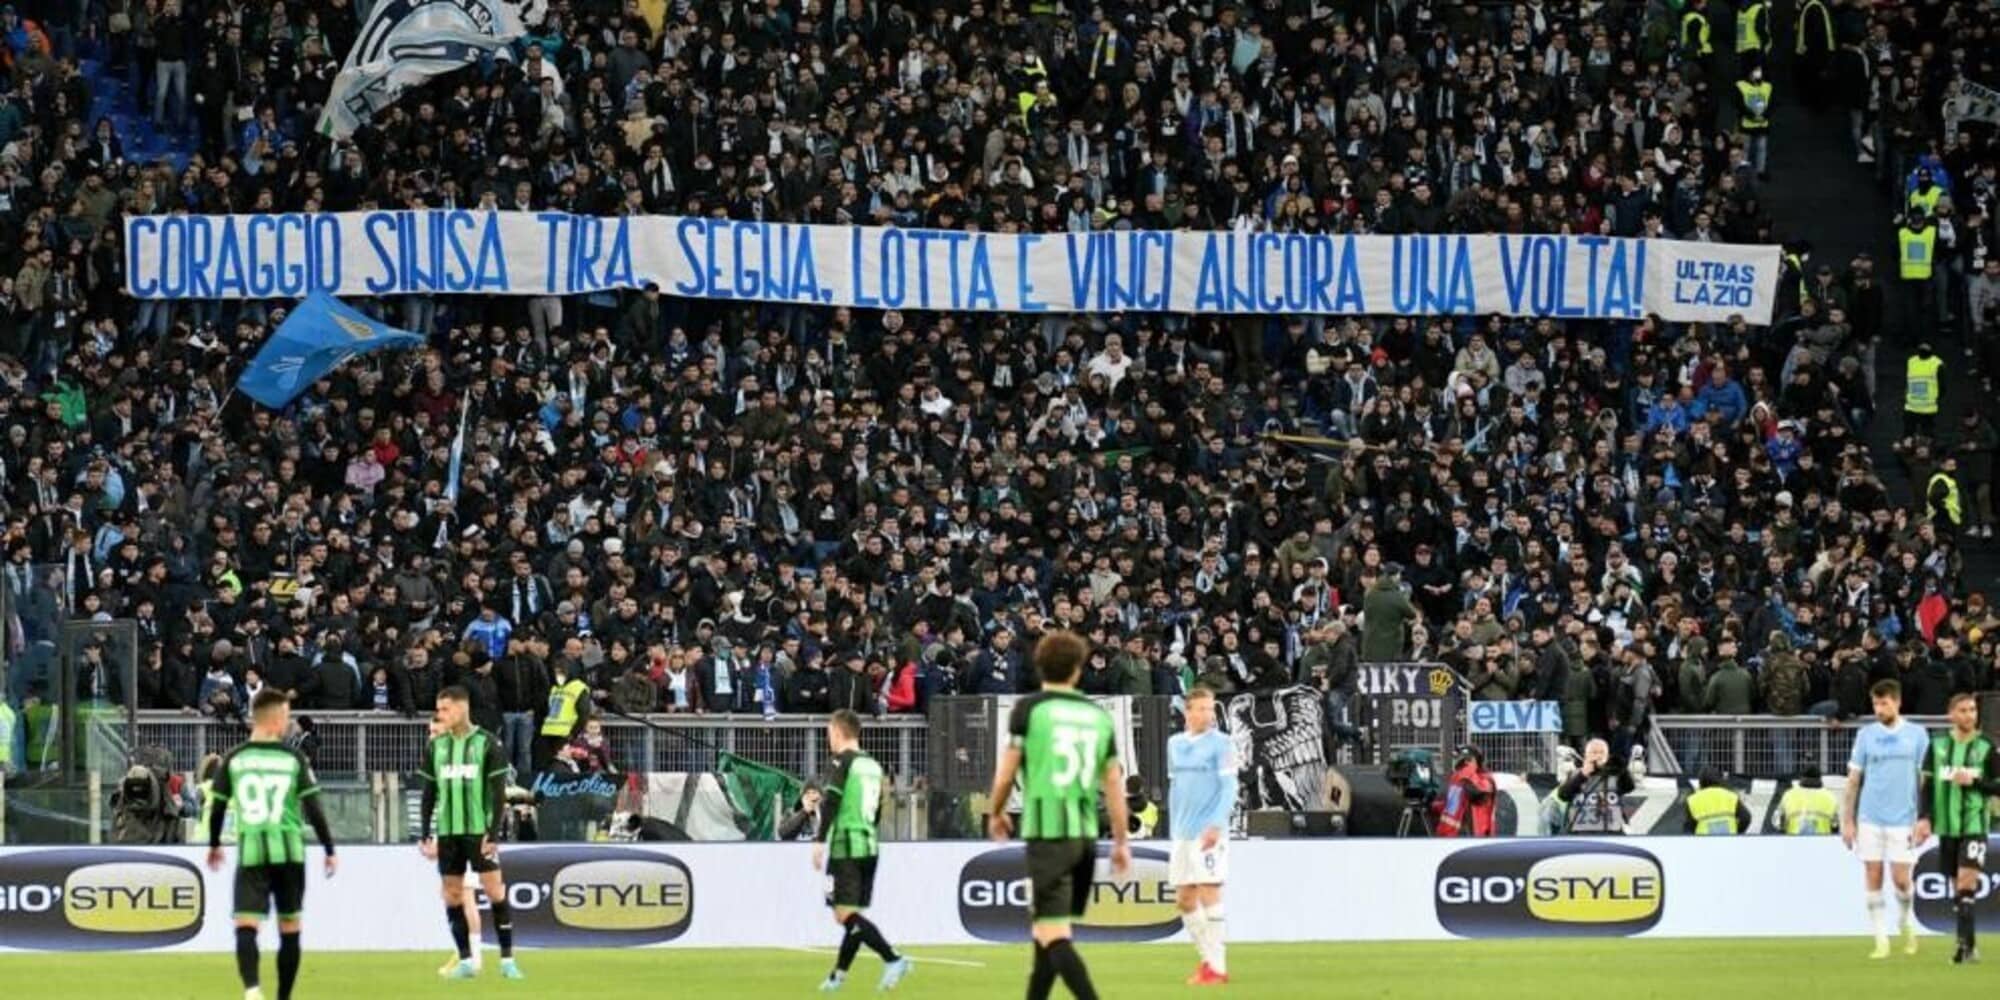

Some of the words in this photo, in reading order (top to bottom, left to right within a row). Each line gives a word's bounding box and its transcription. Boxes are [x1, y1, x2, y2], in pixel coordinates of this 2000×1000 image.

[129, 213, 341, 298] CORAGGIO
[365, 208, 510, 293] SINISA
[676, 217, 834, 304] SEGNA,
[851, 228, 999, 310] LOTTA
[1015, 233, 1048, 313] E
[1066, 230, 1175, 313] VINCI
[1195, 232, 1366, 315] ANCORA
[1391, 235, 1478, 316] UNA
[1500, 235, 1646, 319] VOLTA!
[1676, 259, 1755, 284] ULTRAS
[1675, 281, 1753, 307] LAZIO
[1392, 699, 1441, 728] ROI
[531, 771, 618, 798] Marcolino
[238, 772, 291, 825] 97
[1204, 853, 1216, 870] 6
[70, 886, 196, 910] STYLE
[558, 883, 684, 908] STYLE
[1091, 881, 1177, 904] TYLE
[1438, 876, 1525, 904] GIO'
[1533, 877, 1656, 901] STYLE
